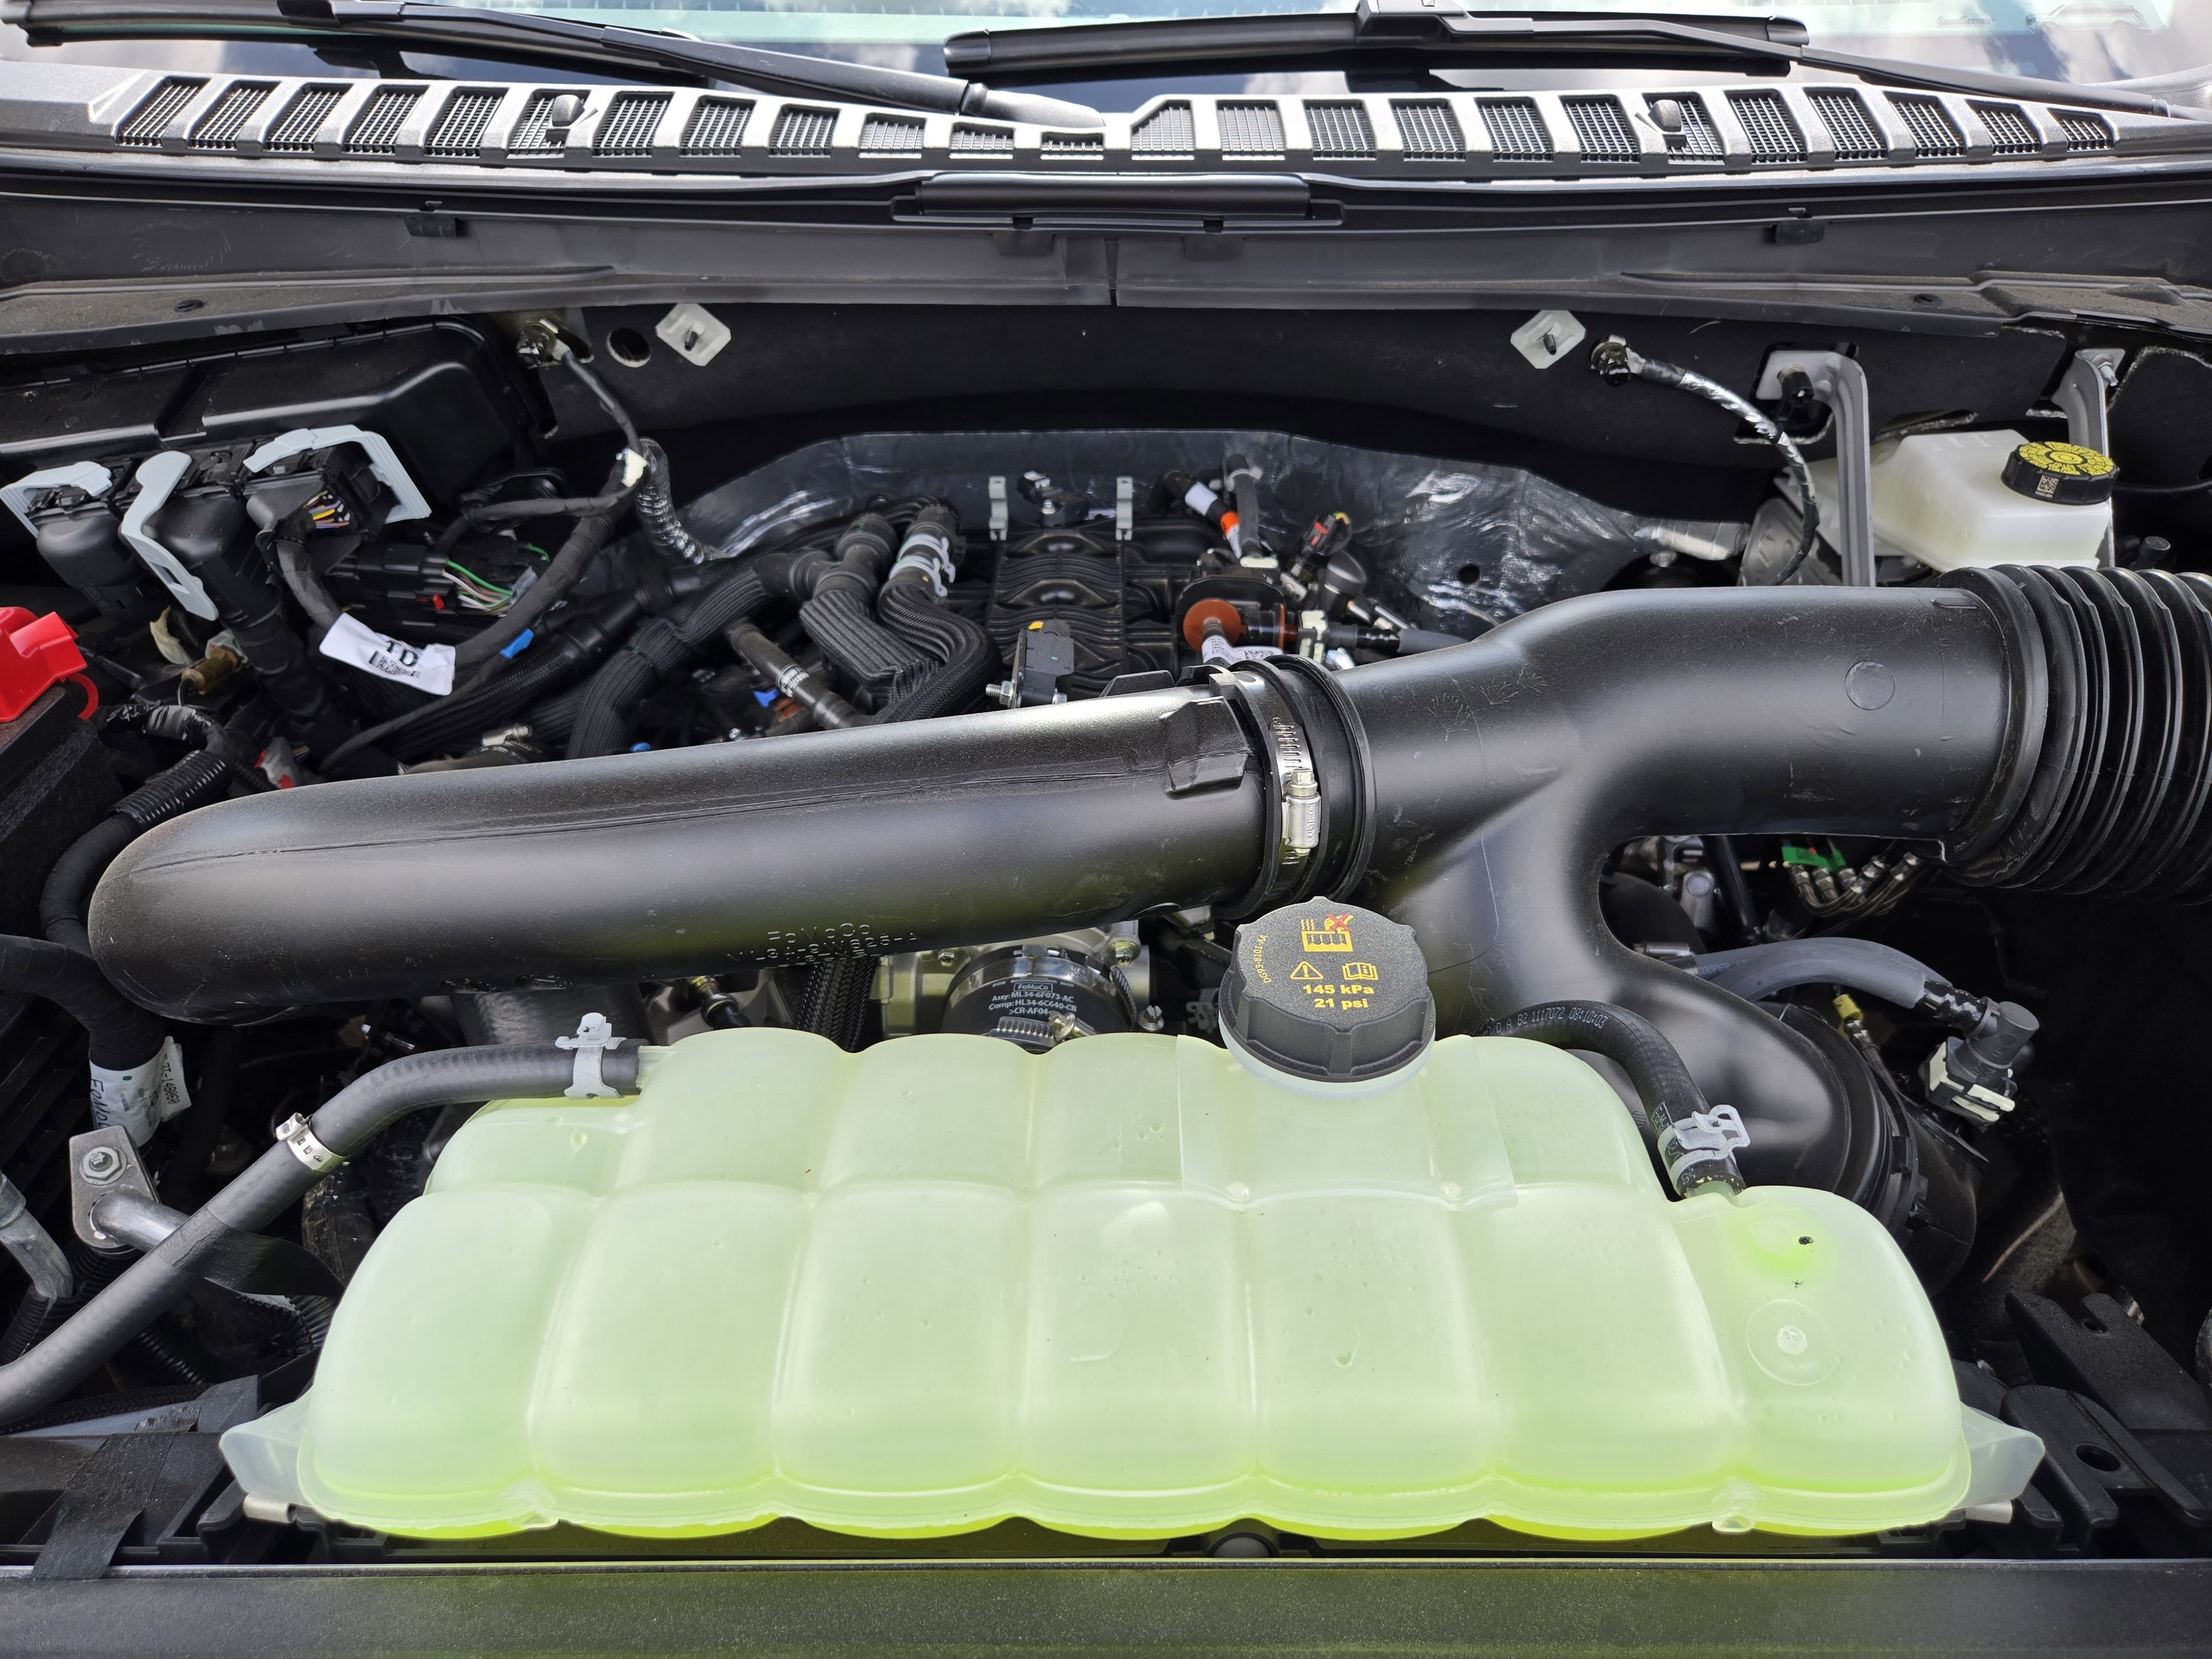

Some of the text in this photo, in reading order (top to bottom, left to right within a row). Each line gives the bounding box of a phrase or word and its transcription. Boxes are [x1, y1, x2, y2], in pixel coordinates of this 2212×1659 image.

[1303, 984, 1374, 994] 145 kPa
[1313, 998, 1368, 1010] 21 psi
